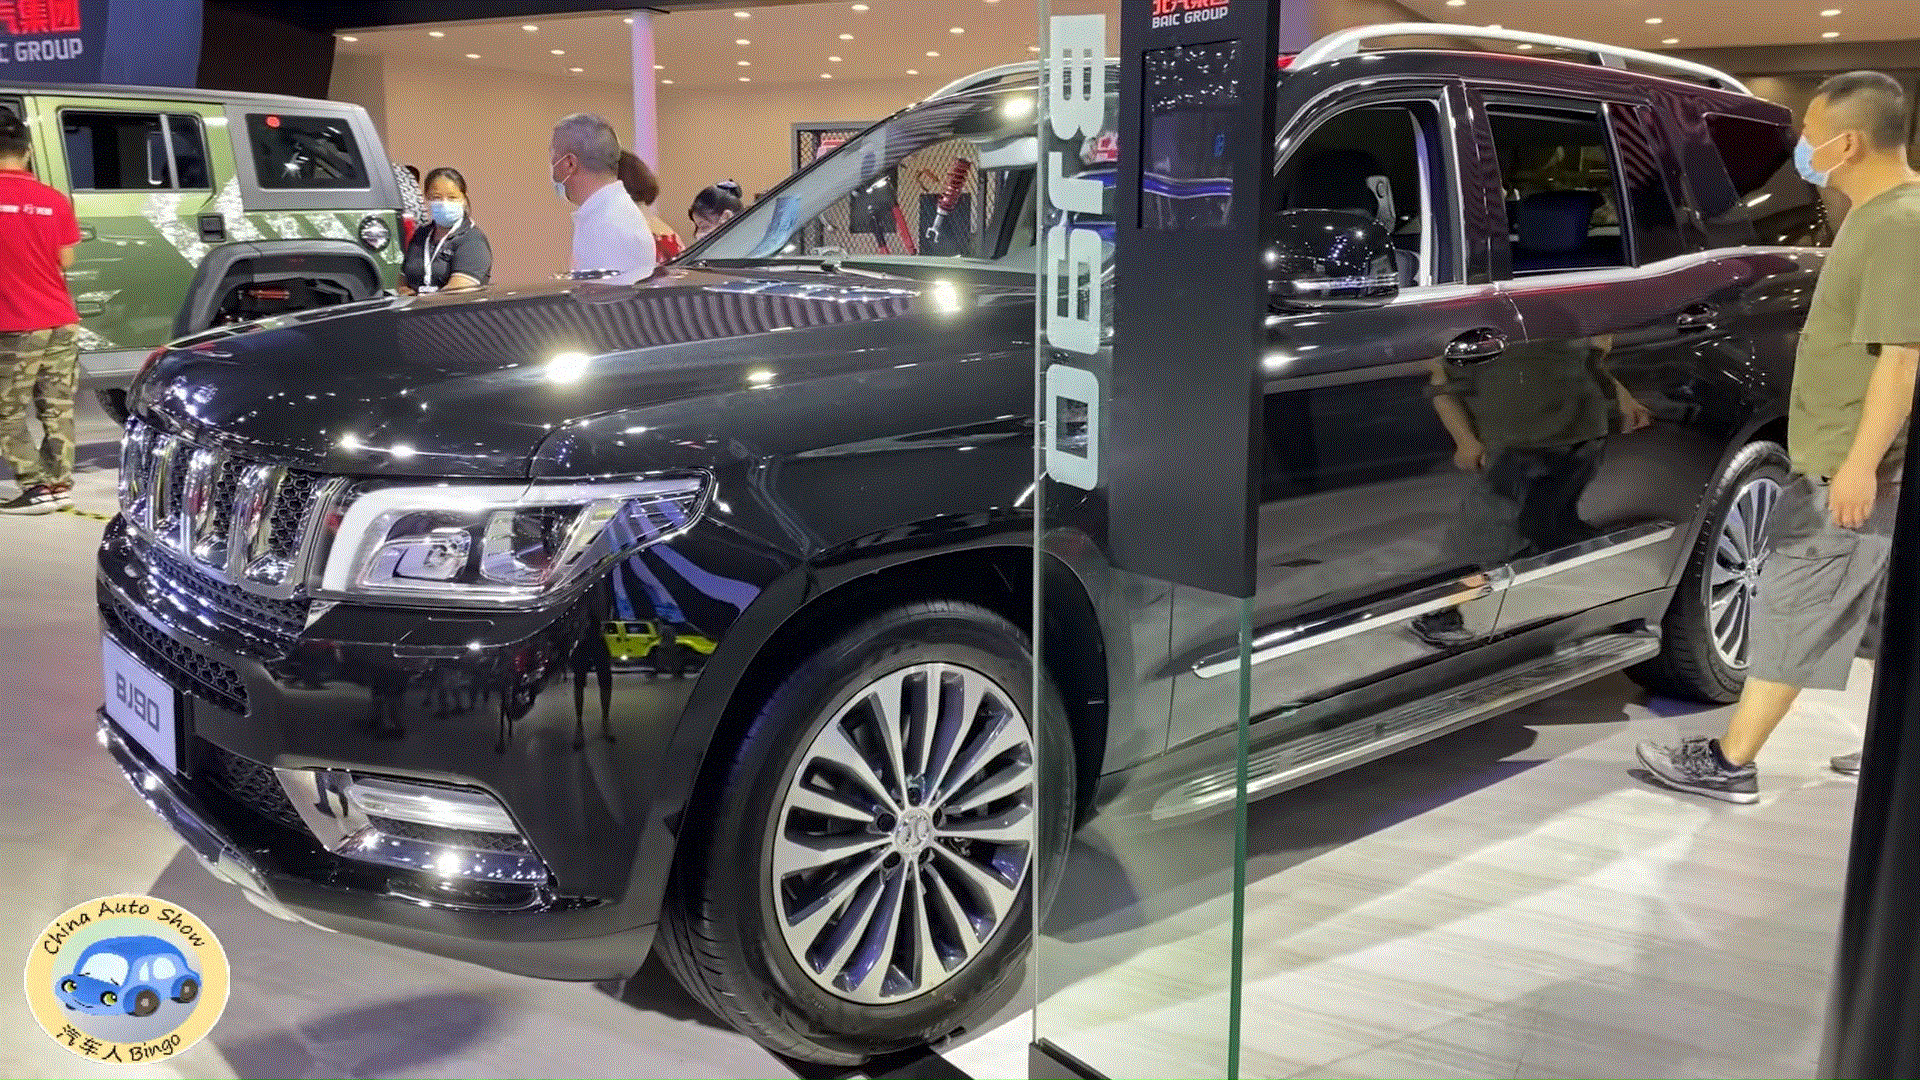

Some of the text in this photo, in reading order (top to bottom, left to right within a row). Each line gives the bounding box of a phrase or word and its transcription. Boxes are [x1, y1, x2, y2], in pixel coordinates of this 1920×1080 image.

[1152, 13, 1180, 29] BAIC
[1184, 6, 1229, 24] GROUP
[14, 38, 83, 62] GROUP
[1046, 14, 1106, 492] BJ90
[116, 670, 160, 732] BJ90
